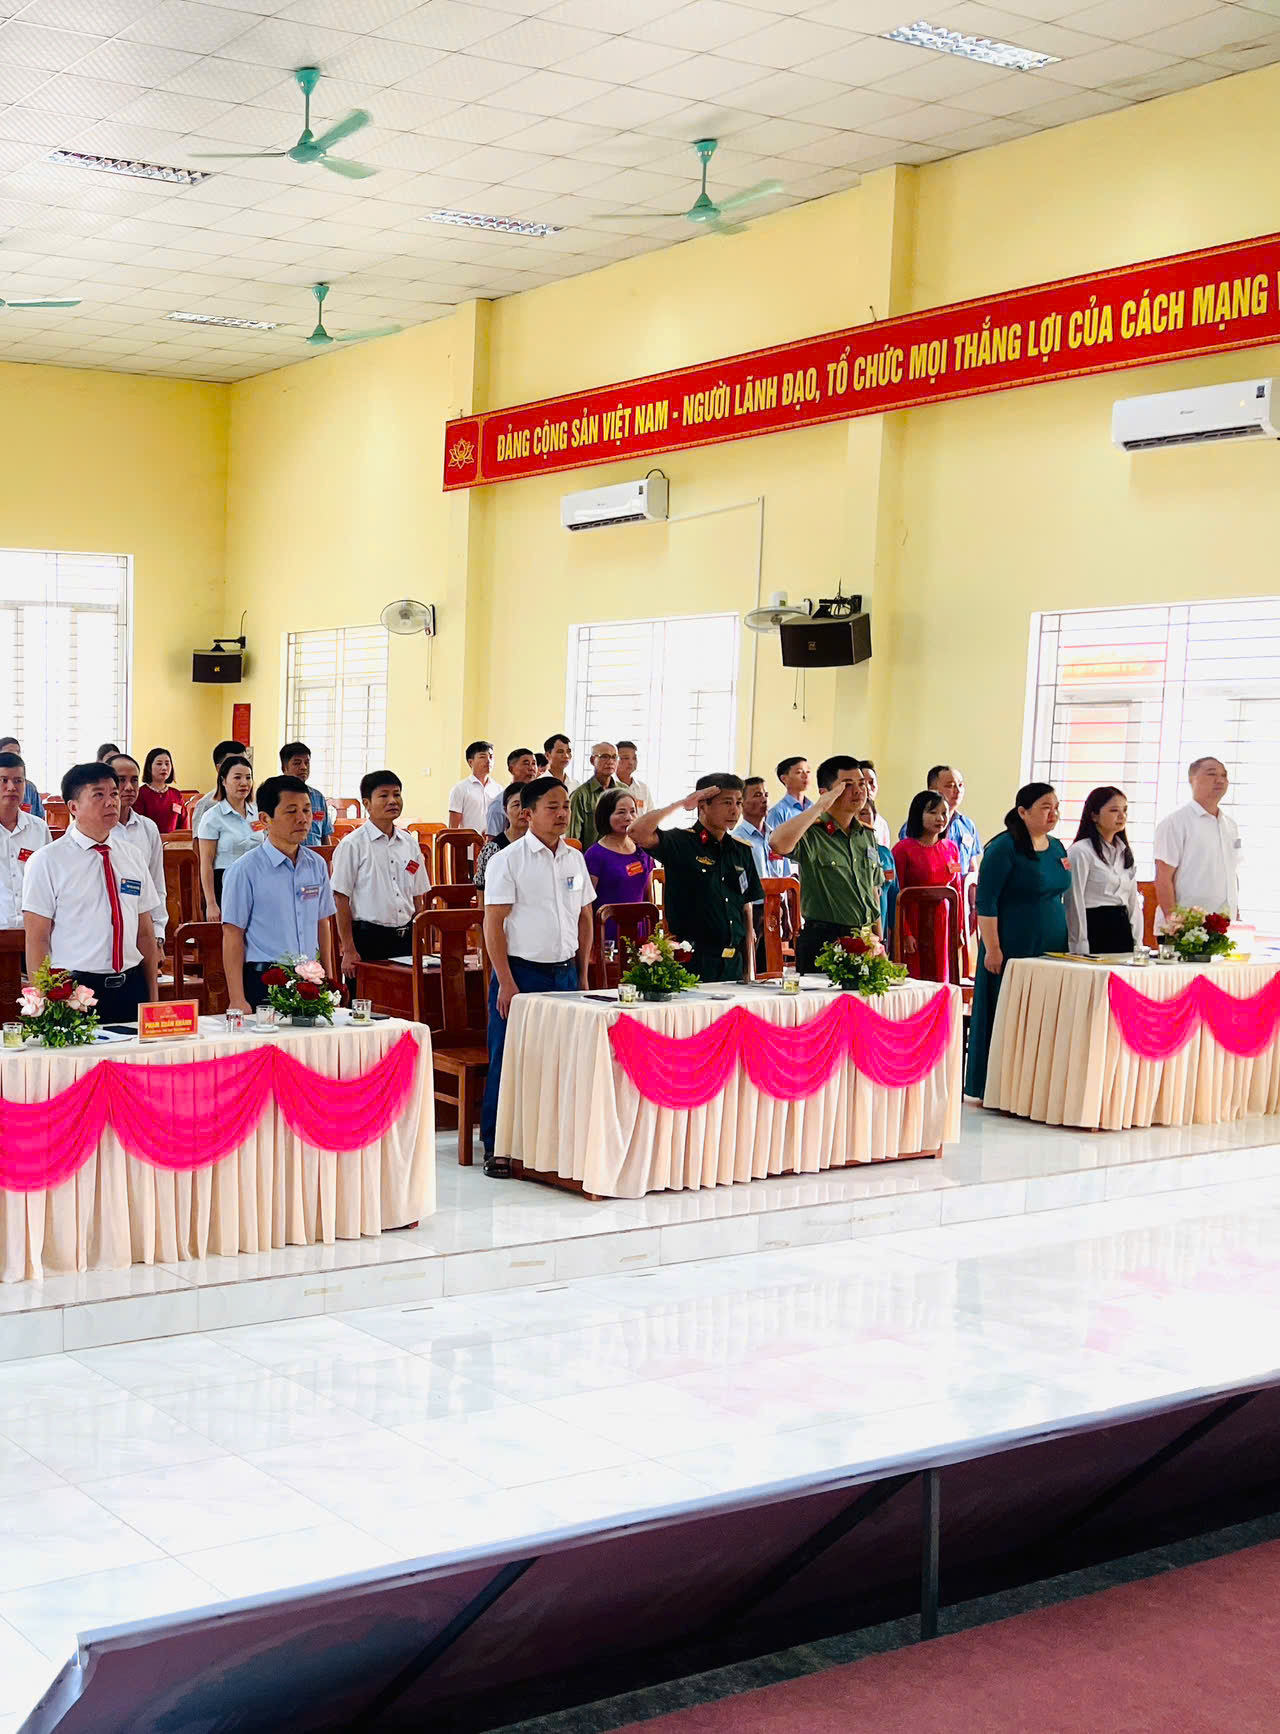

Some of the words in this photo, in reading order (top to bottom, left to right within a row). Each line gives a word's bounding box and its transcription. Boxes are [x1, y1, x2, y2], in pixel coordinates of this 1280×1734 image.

[497, 423, 530, 462] ĐẢNG
[533, 419, 568, 460] CỘNG
[571, 408, 599, 448] SẢN
[603, 403, 632, 446] VIỆT
[634, 400, 669, 436] NAM
[682, 380, 731, 426] NGƯỜI
[734, 375, 778, 416] LÃNH
[781, 367, 820, 411] ĐẠO,
[827, 346, 850, 397] TỔ
[853, 344, 904, 391] CHỨC
[908, 339, 948, 384] MỌI
[953, 316, 1022, 371] THẮNG
[1027, 312, 1062, 364] LỢI
[1068, 296, 1114, 349] CỦA
[1120, 288, 1185, 340] CÁCH
[1191, 273, 1268, 331] MẠNG
